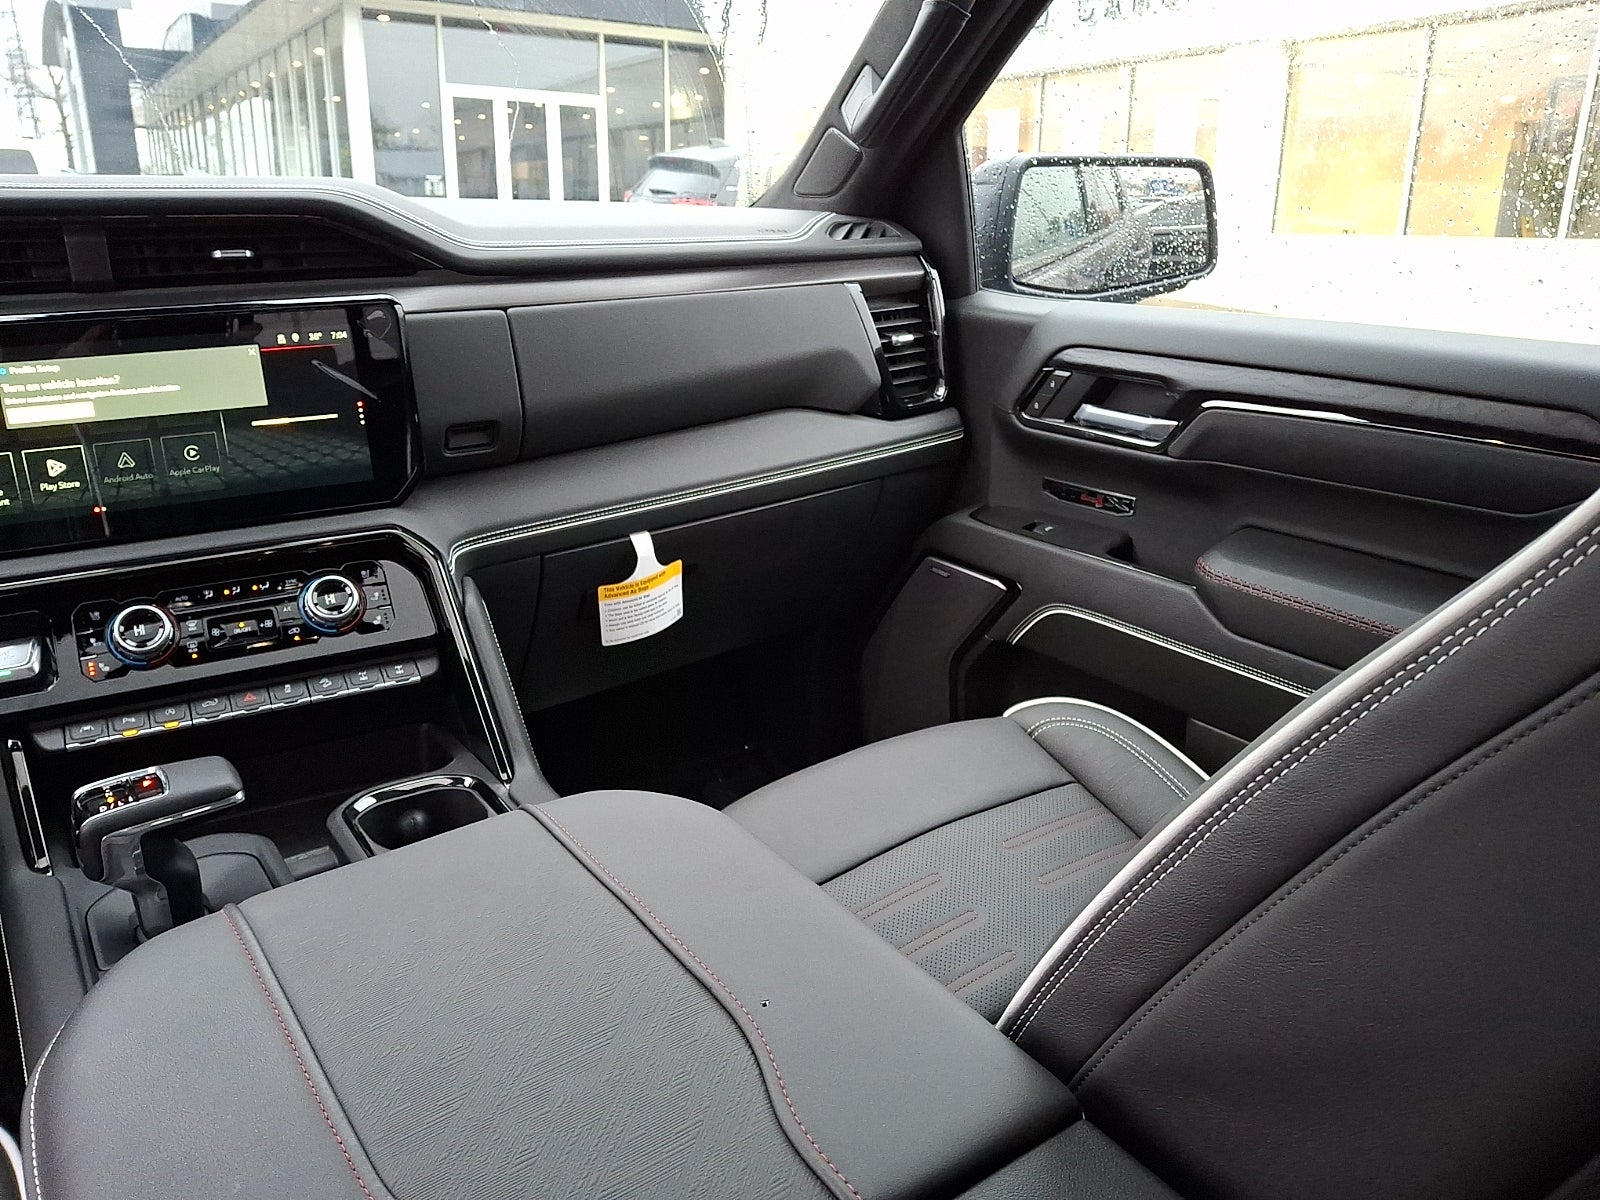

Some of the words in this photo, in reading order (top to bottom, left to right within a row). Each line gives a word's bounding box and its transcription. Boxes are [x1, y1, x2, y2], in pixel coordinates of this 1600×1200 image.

[169, 467, 191, 477] Apple
[192, 464, 221, 475] CarPlay
[103, 473, 134, 484] Android
[134, 472, 154, 481] Auto
[40, 481, 58, 492] Play
[58, 480, 81, 490] Store
[615, 583, 634, 592] Vehicle
[324, 593, 336, 605] HI
[604, 590, 630, 599] Advanced
[134, 624, 146, 637] HI
